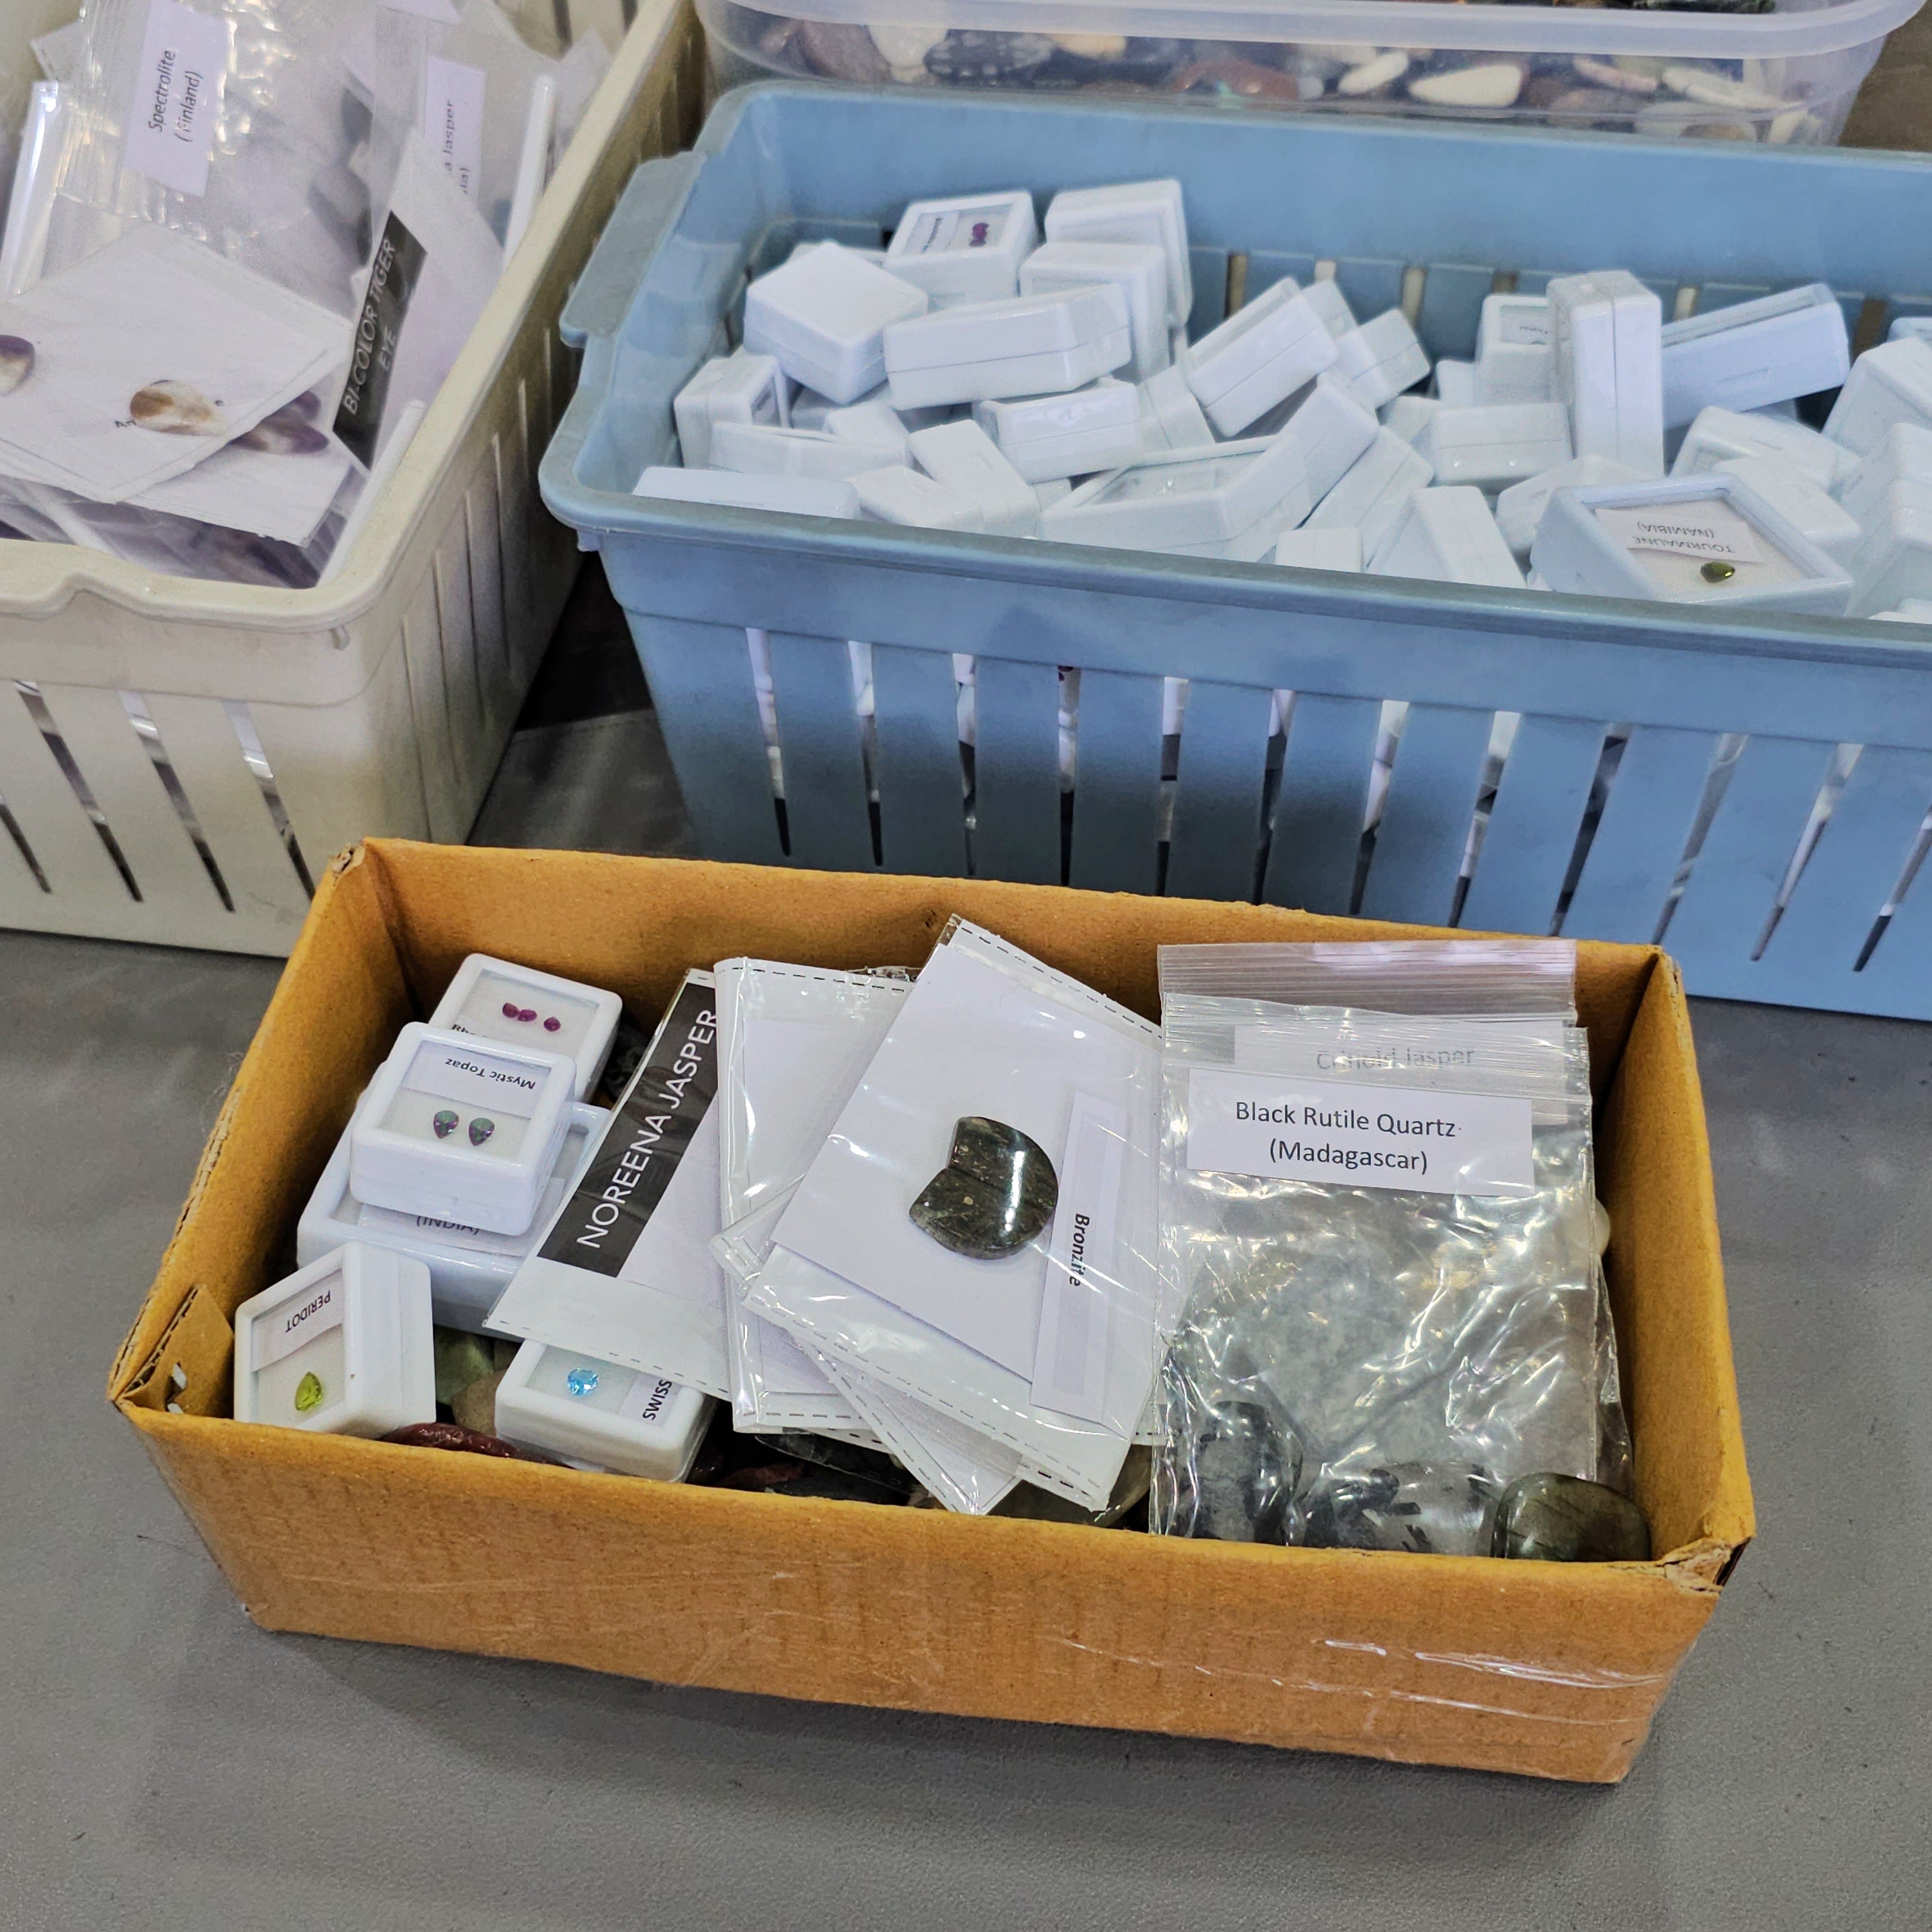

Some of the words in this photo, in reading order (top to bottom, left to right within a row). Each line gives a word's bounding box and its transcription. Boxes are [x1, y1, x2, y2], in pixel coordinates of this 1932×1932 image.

[148, 50, 176, 133] Spectrolite
[174, 71, 204, 142] (Finland)
[442, 99, 455, 156] Jasper
[342, 305, 378, 415] BI-COLOR
[369, 239, 396, 303] TIGER
[378, 327, 397, 372] EYE
[1632, 536, 1736, 553] TOURMALINE
[1637, 522, 1715, 539] (NAMIBIA)
[445, 1058, 486, 1077] Topaz
[489, 1071, 536, 1089] Mystic
[577, 1115, 672, 1248] NOREENA
[659, 1009, 717, 1109] JASPER
[1236, 1101, 1296, 1124] Black
[1304, 1106, 1370, 1130] Rutile
[1376, 1113, 1457, 1137] Quartz
[1269, 1138, 1428, 1175] (Madagascar)
[1069, 1213, 1091, 1287] Bronzite
[285, 1290, 331, 1333] PERIDOT
[642, 1379, 673, 1421] SWISS
